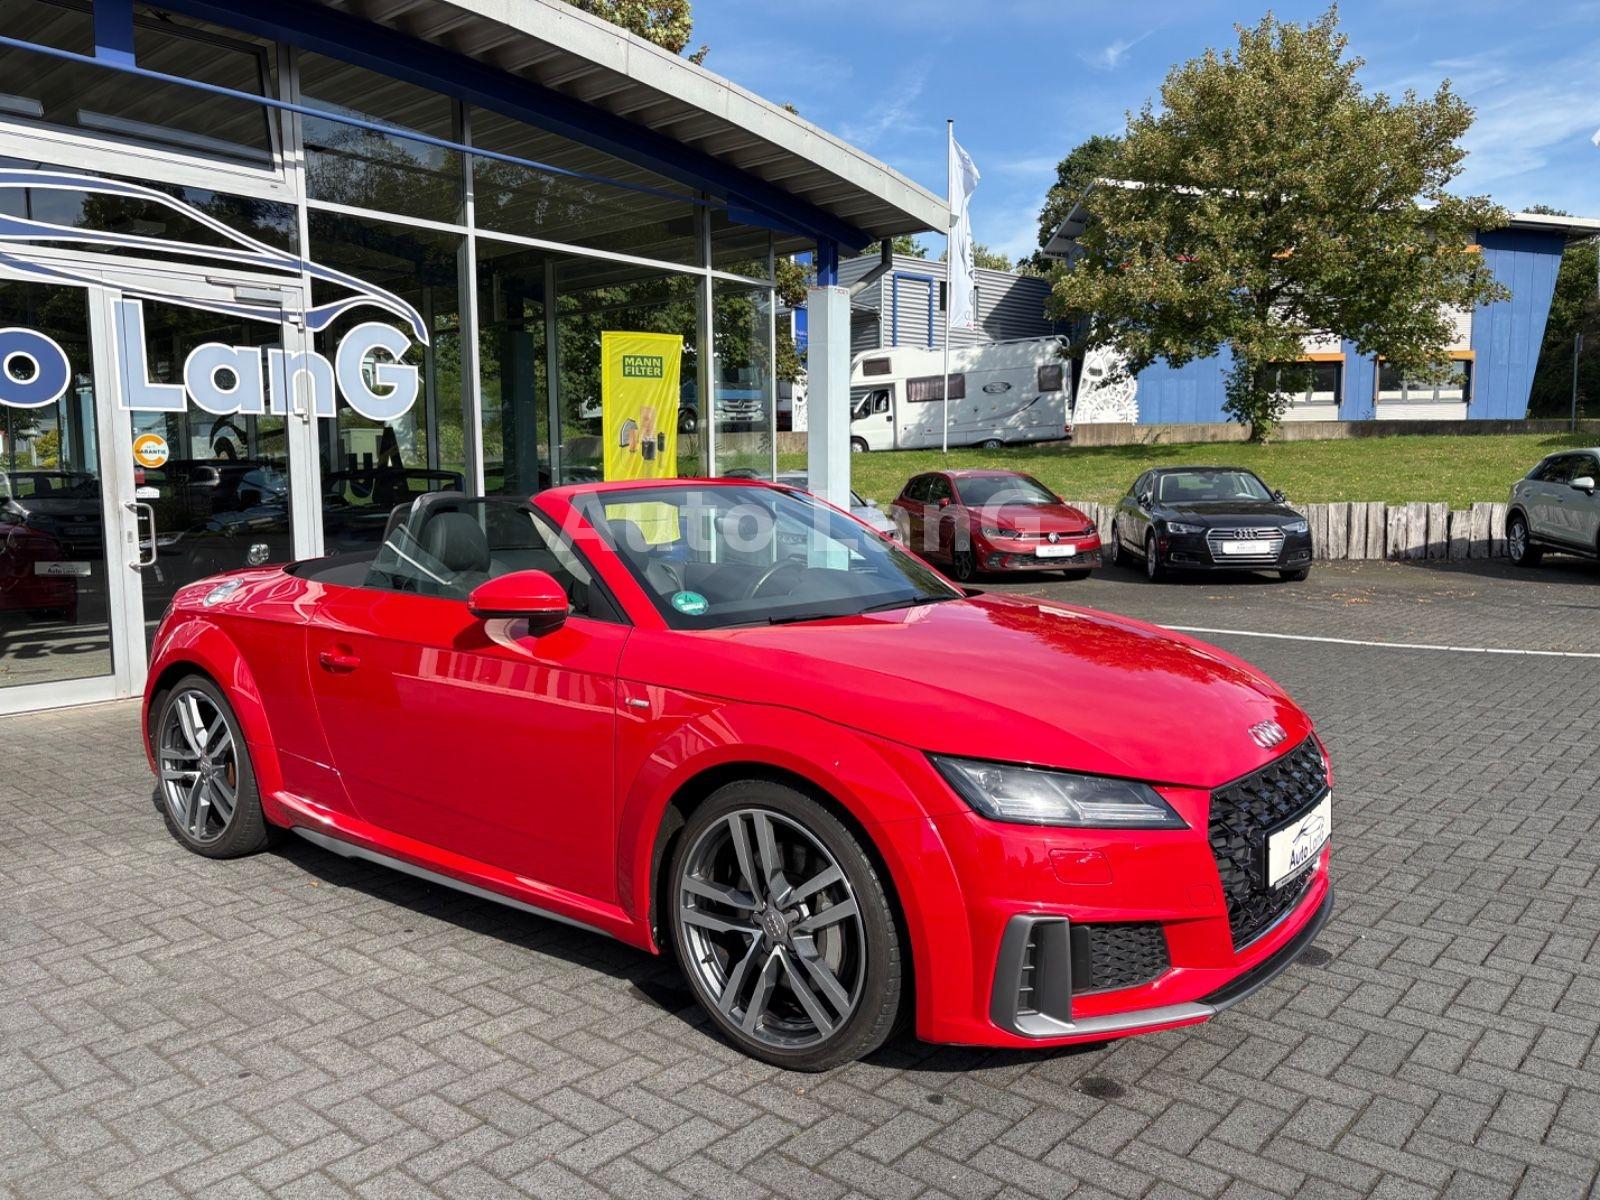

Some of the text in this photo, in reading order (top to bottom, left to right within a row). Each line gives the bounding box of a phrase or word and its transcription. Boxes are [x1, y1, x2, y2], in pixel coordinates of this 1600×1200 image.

[111, 298, 418, 420] LanG
[624, 357, 661, 367] MANN
[624, 366, 662, 376] FILTER
[1289, 845, 1308, 869] Auto
